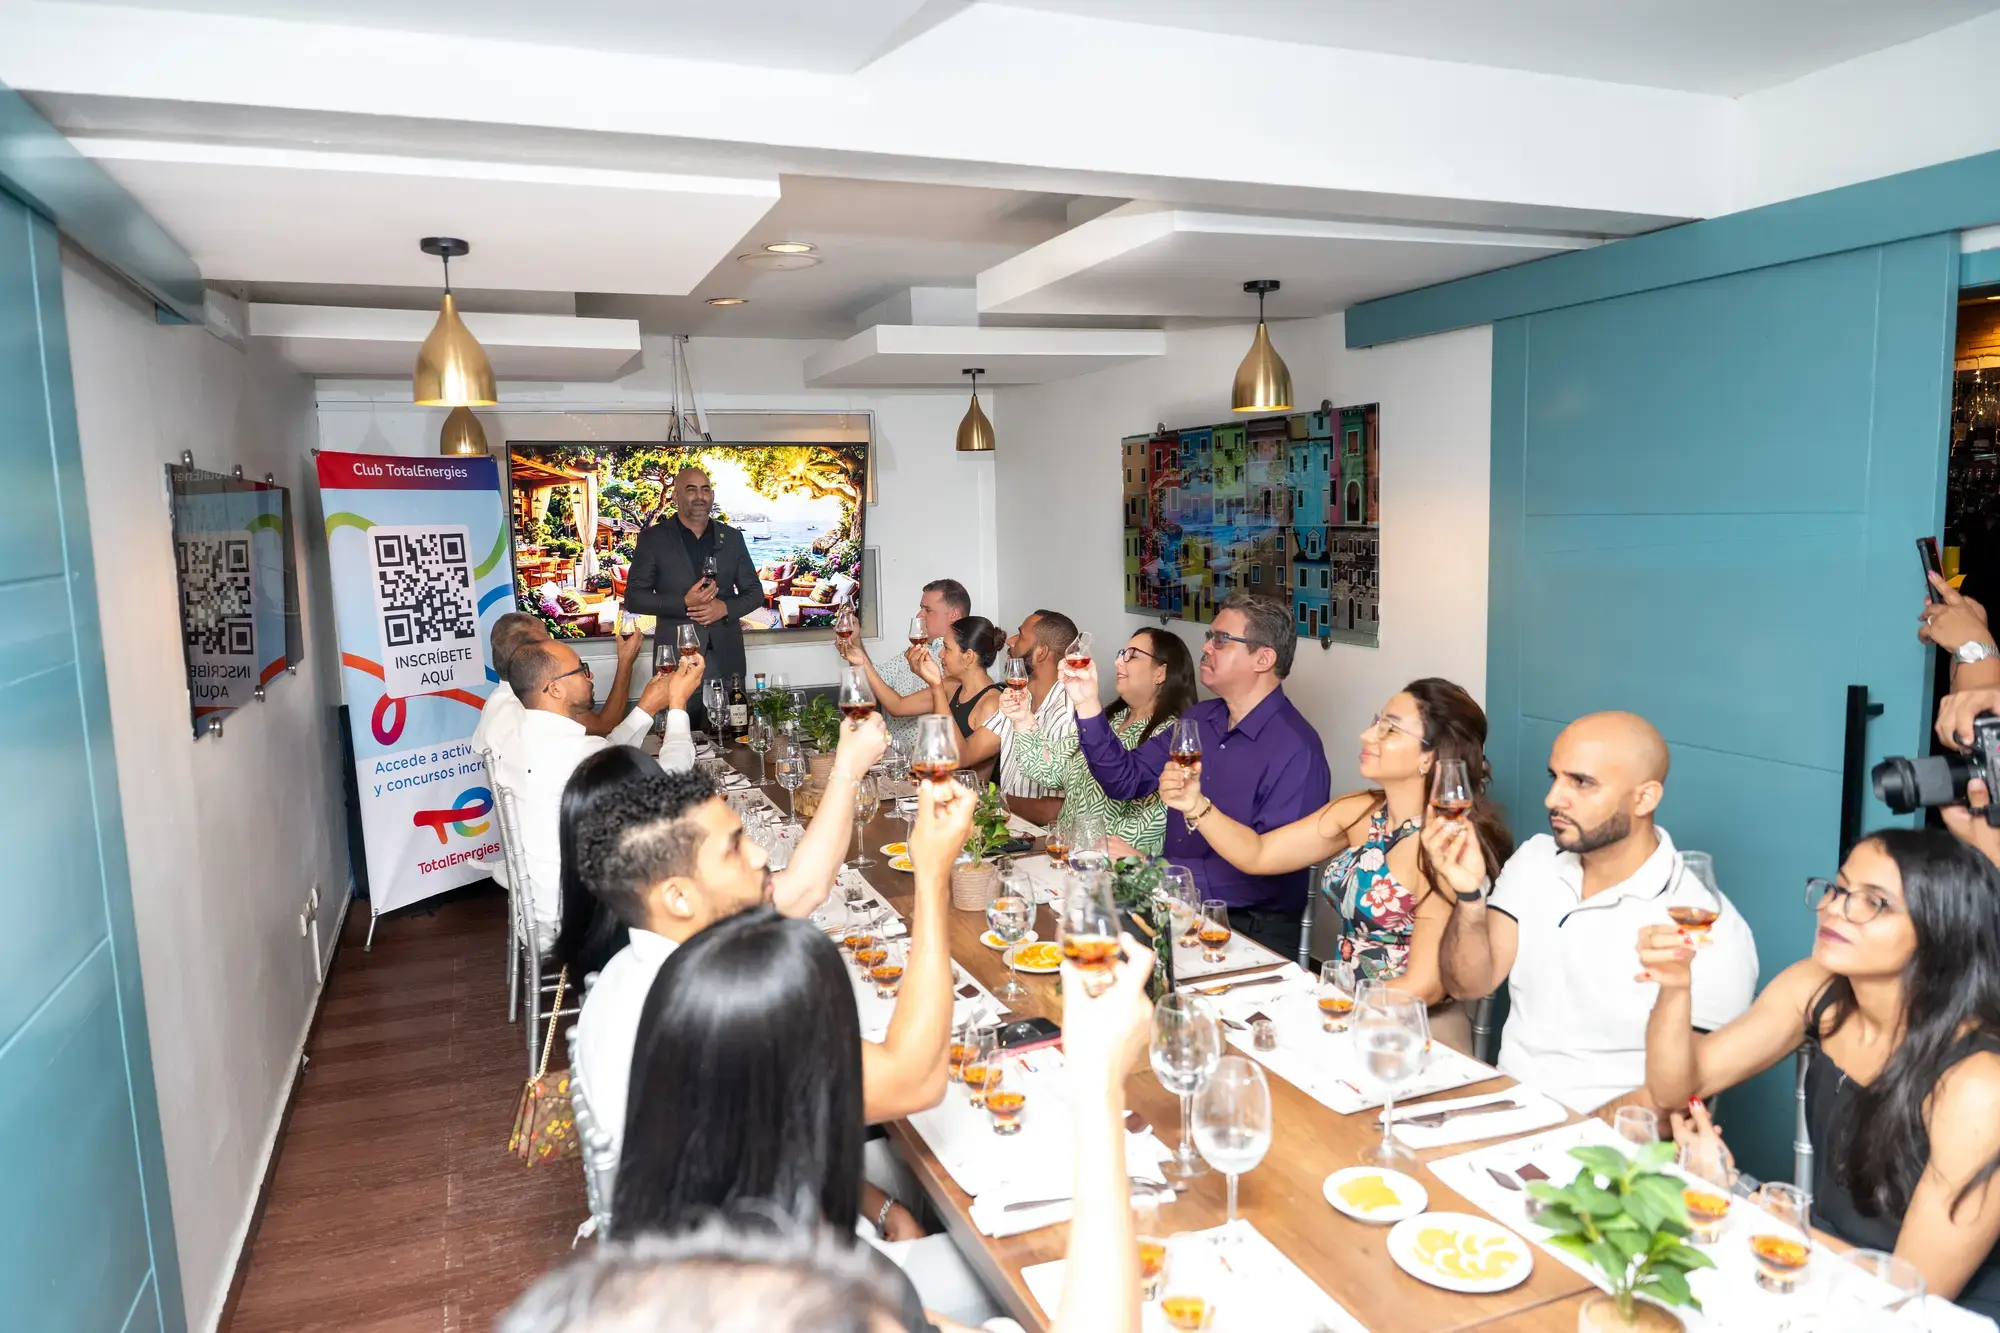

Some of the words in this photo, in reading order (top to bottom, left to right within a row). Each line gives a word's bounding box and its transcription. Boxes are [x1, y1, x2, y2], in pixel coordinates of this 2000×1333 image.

[353, 463, 383, 476] Club
[385, 463, 468, 480] TotalEnergies
[395, 648, 472, 669] INSCRÍBETE
[421, 665, 454, 685] AQUÍ
[375, 753, 426, 775] Accede
[431, 752, 438, 763] a
[442, 743, 476, 760] activ
[373, 784, 382, 798] y
[387, 767, 455, 792] concursos
[418, 842, 500, 875] TotalEnergies
